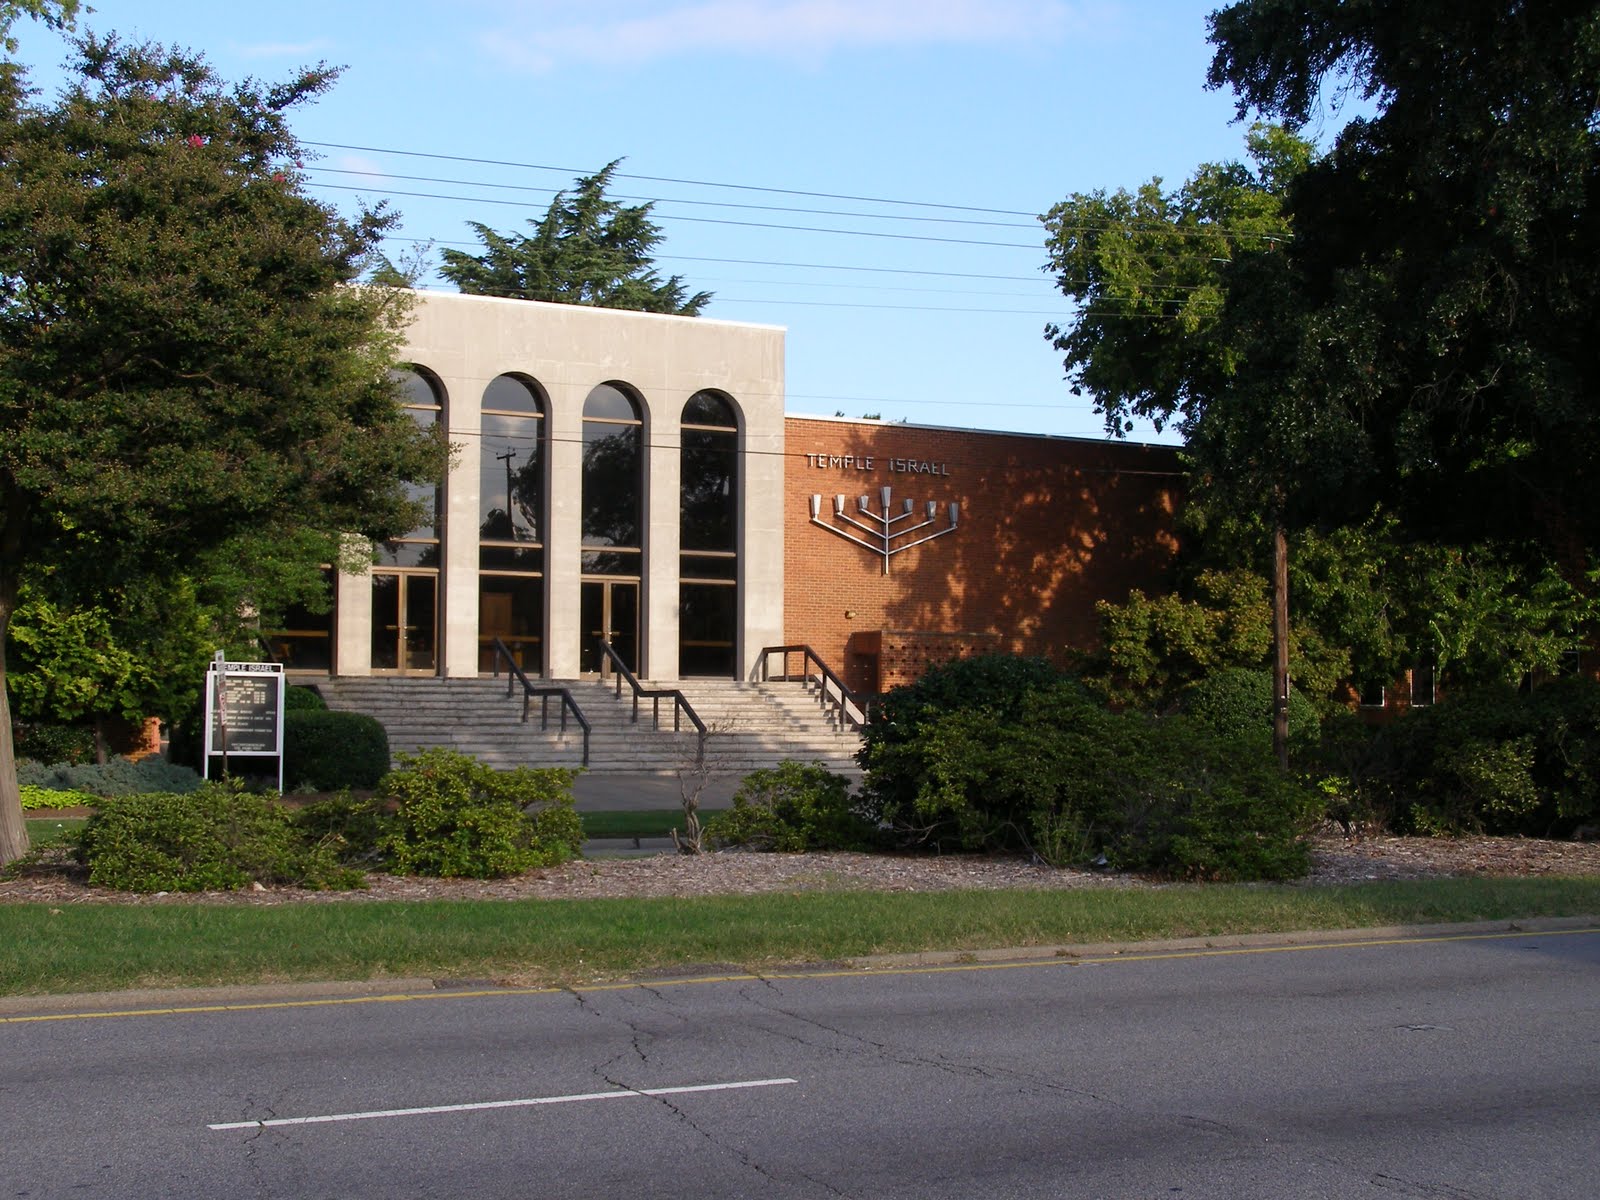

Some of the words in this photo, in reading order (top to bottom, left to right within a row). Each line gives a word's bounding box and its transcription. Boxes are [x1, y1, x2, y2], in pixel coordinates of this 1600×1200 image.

[807, 453, 875, 470] TEMPLE
[890, 458, 950, 476] ISRAEL
[222, 664, 247, 672] EMPLE
[249, 664, 274, 672] ISRAEL
